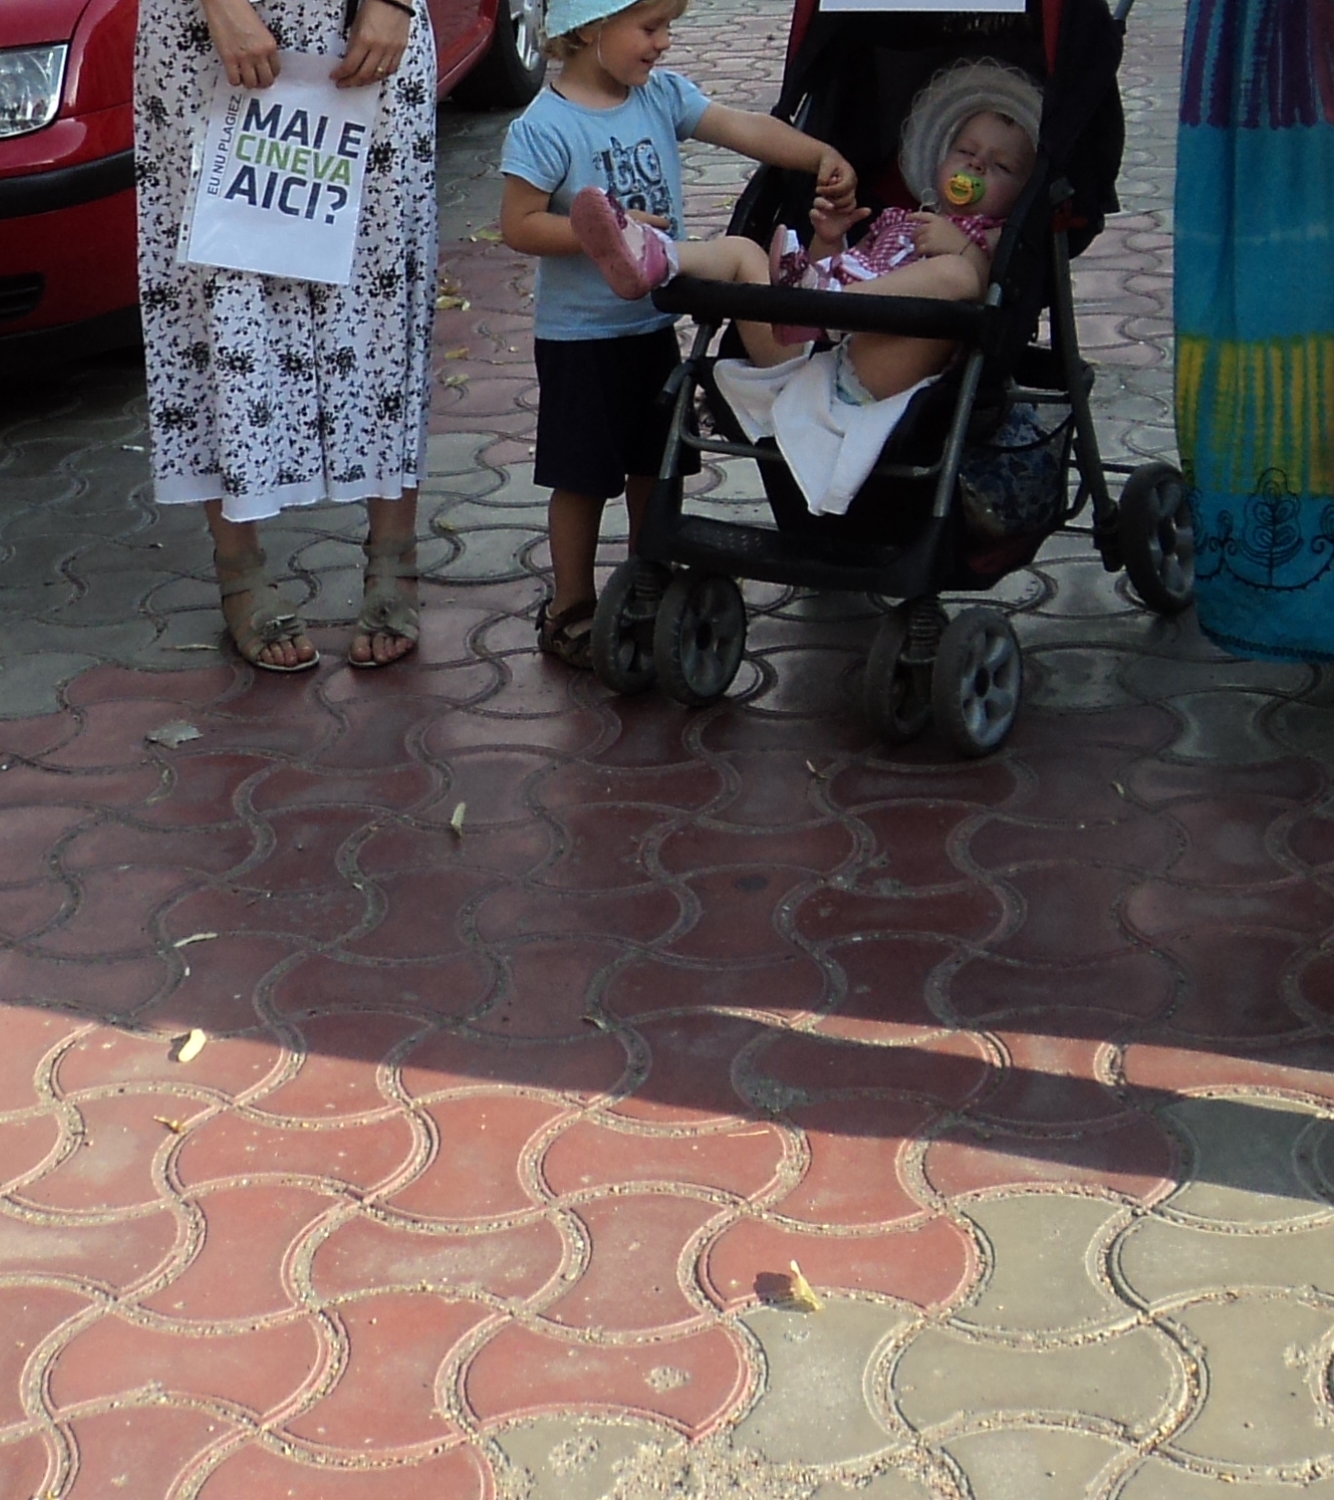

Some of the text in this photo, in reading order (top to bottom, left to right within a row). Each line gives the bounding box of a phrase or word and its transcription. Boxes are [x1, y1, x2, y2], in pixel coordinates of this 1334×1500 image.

[242, 98, 366, 159] MAI E
[207, 176, 223, 195] EU
[213, 156, 226, 178] NU
[235, 135, 352, 186] CINEVA
[224, 165, 348, 225] AICI?
